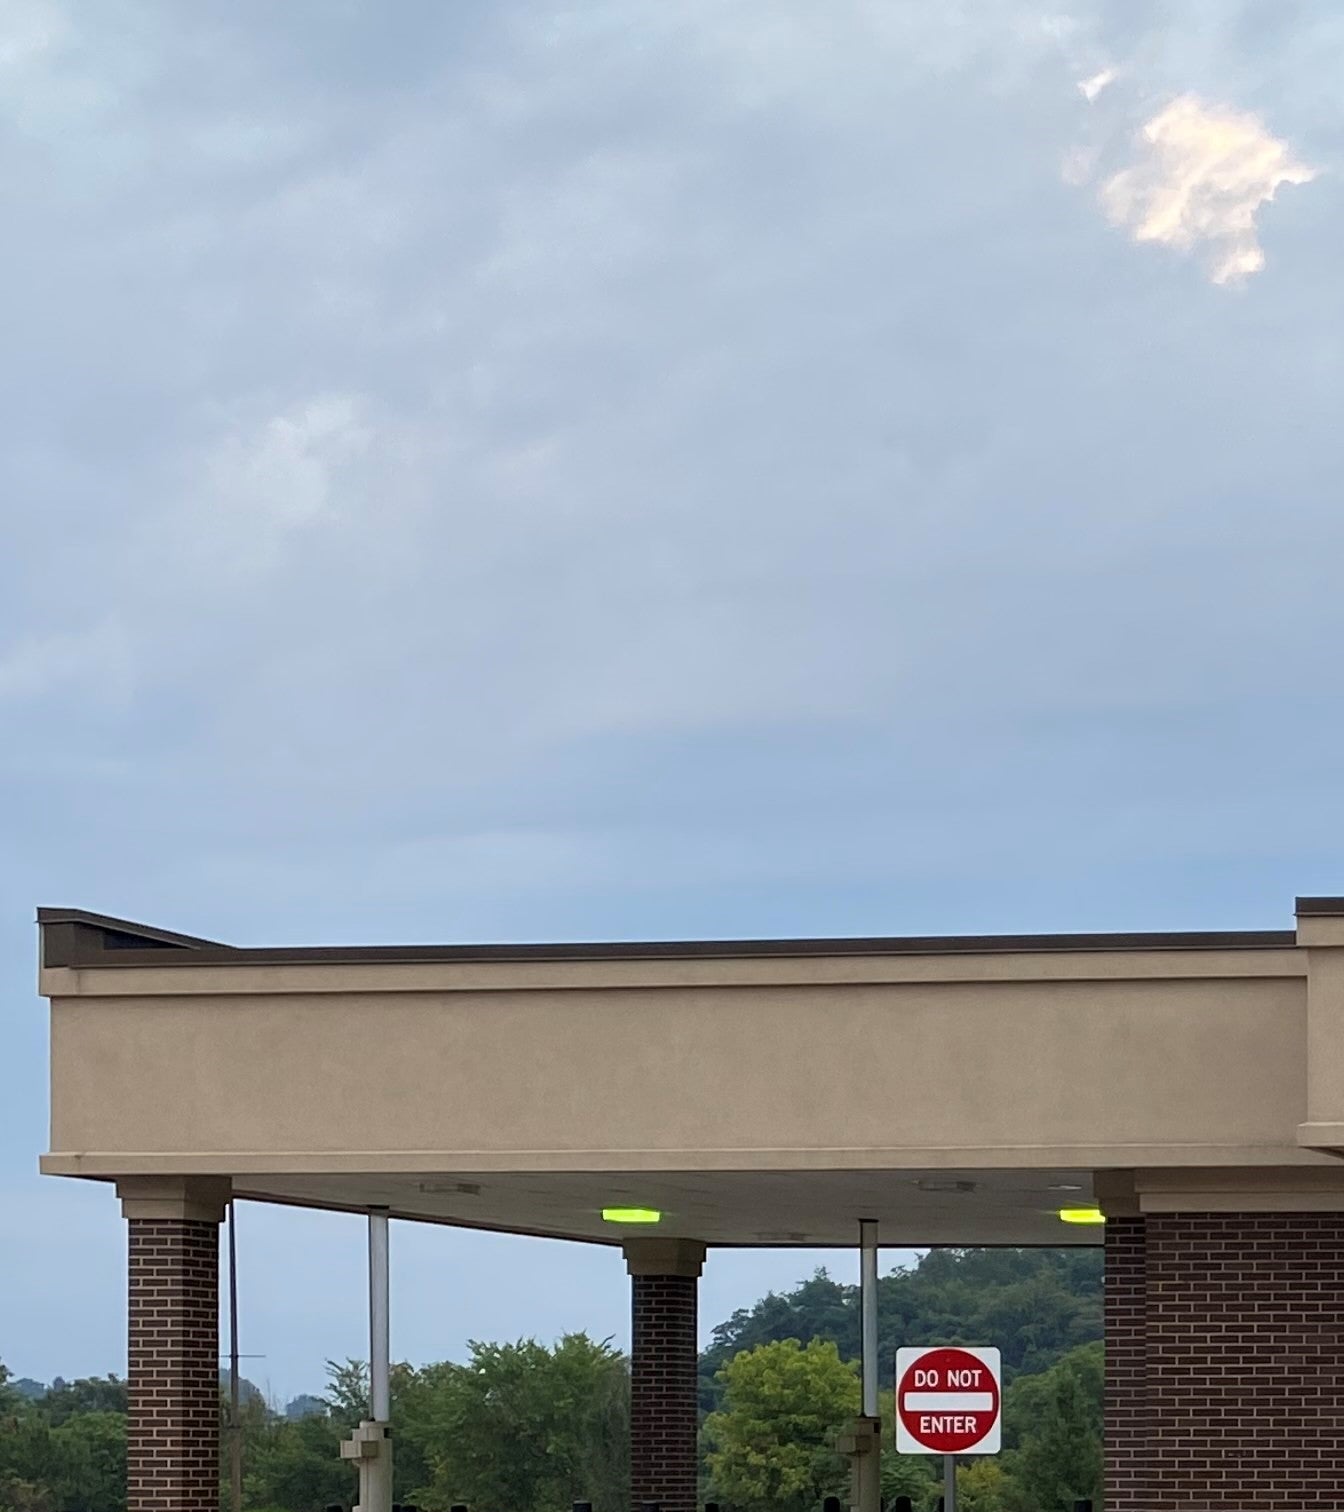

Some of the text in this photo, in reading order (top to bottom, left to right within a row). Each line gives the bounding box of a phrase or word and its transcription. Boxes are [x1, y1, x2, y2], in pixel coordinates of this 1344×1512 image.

[914, 1369, 983, 1388] DO NOT
[919, 1416, 977, 1434] ENTER
